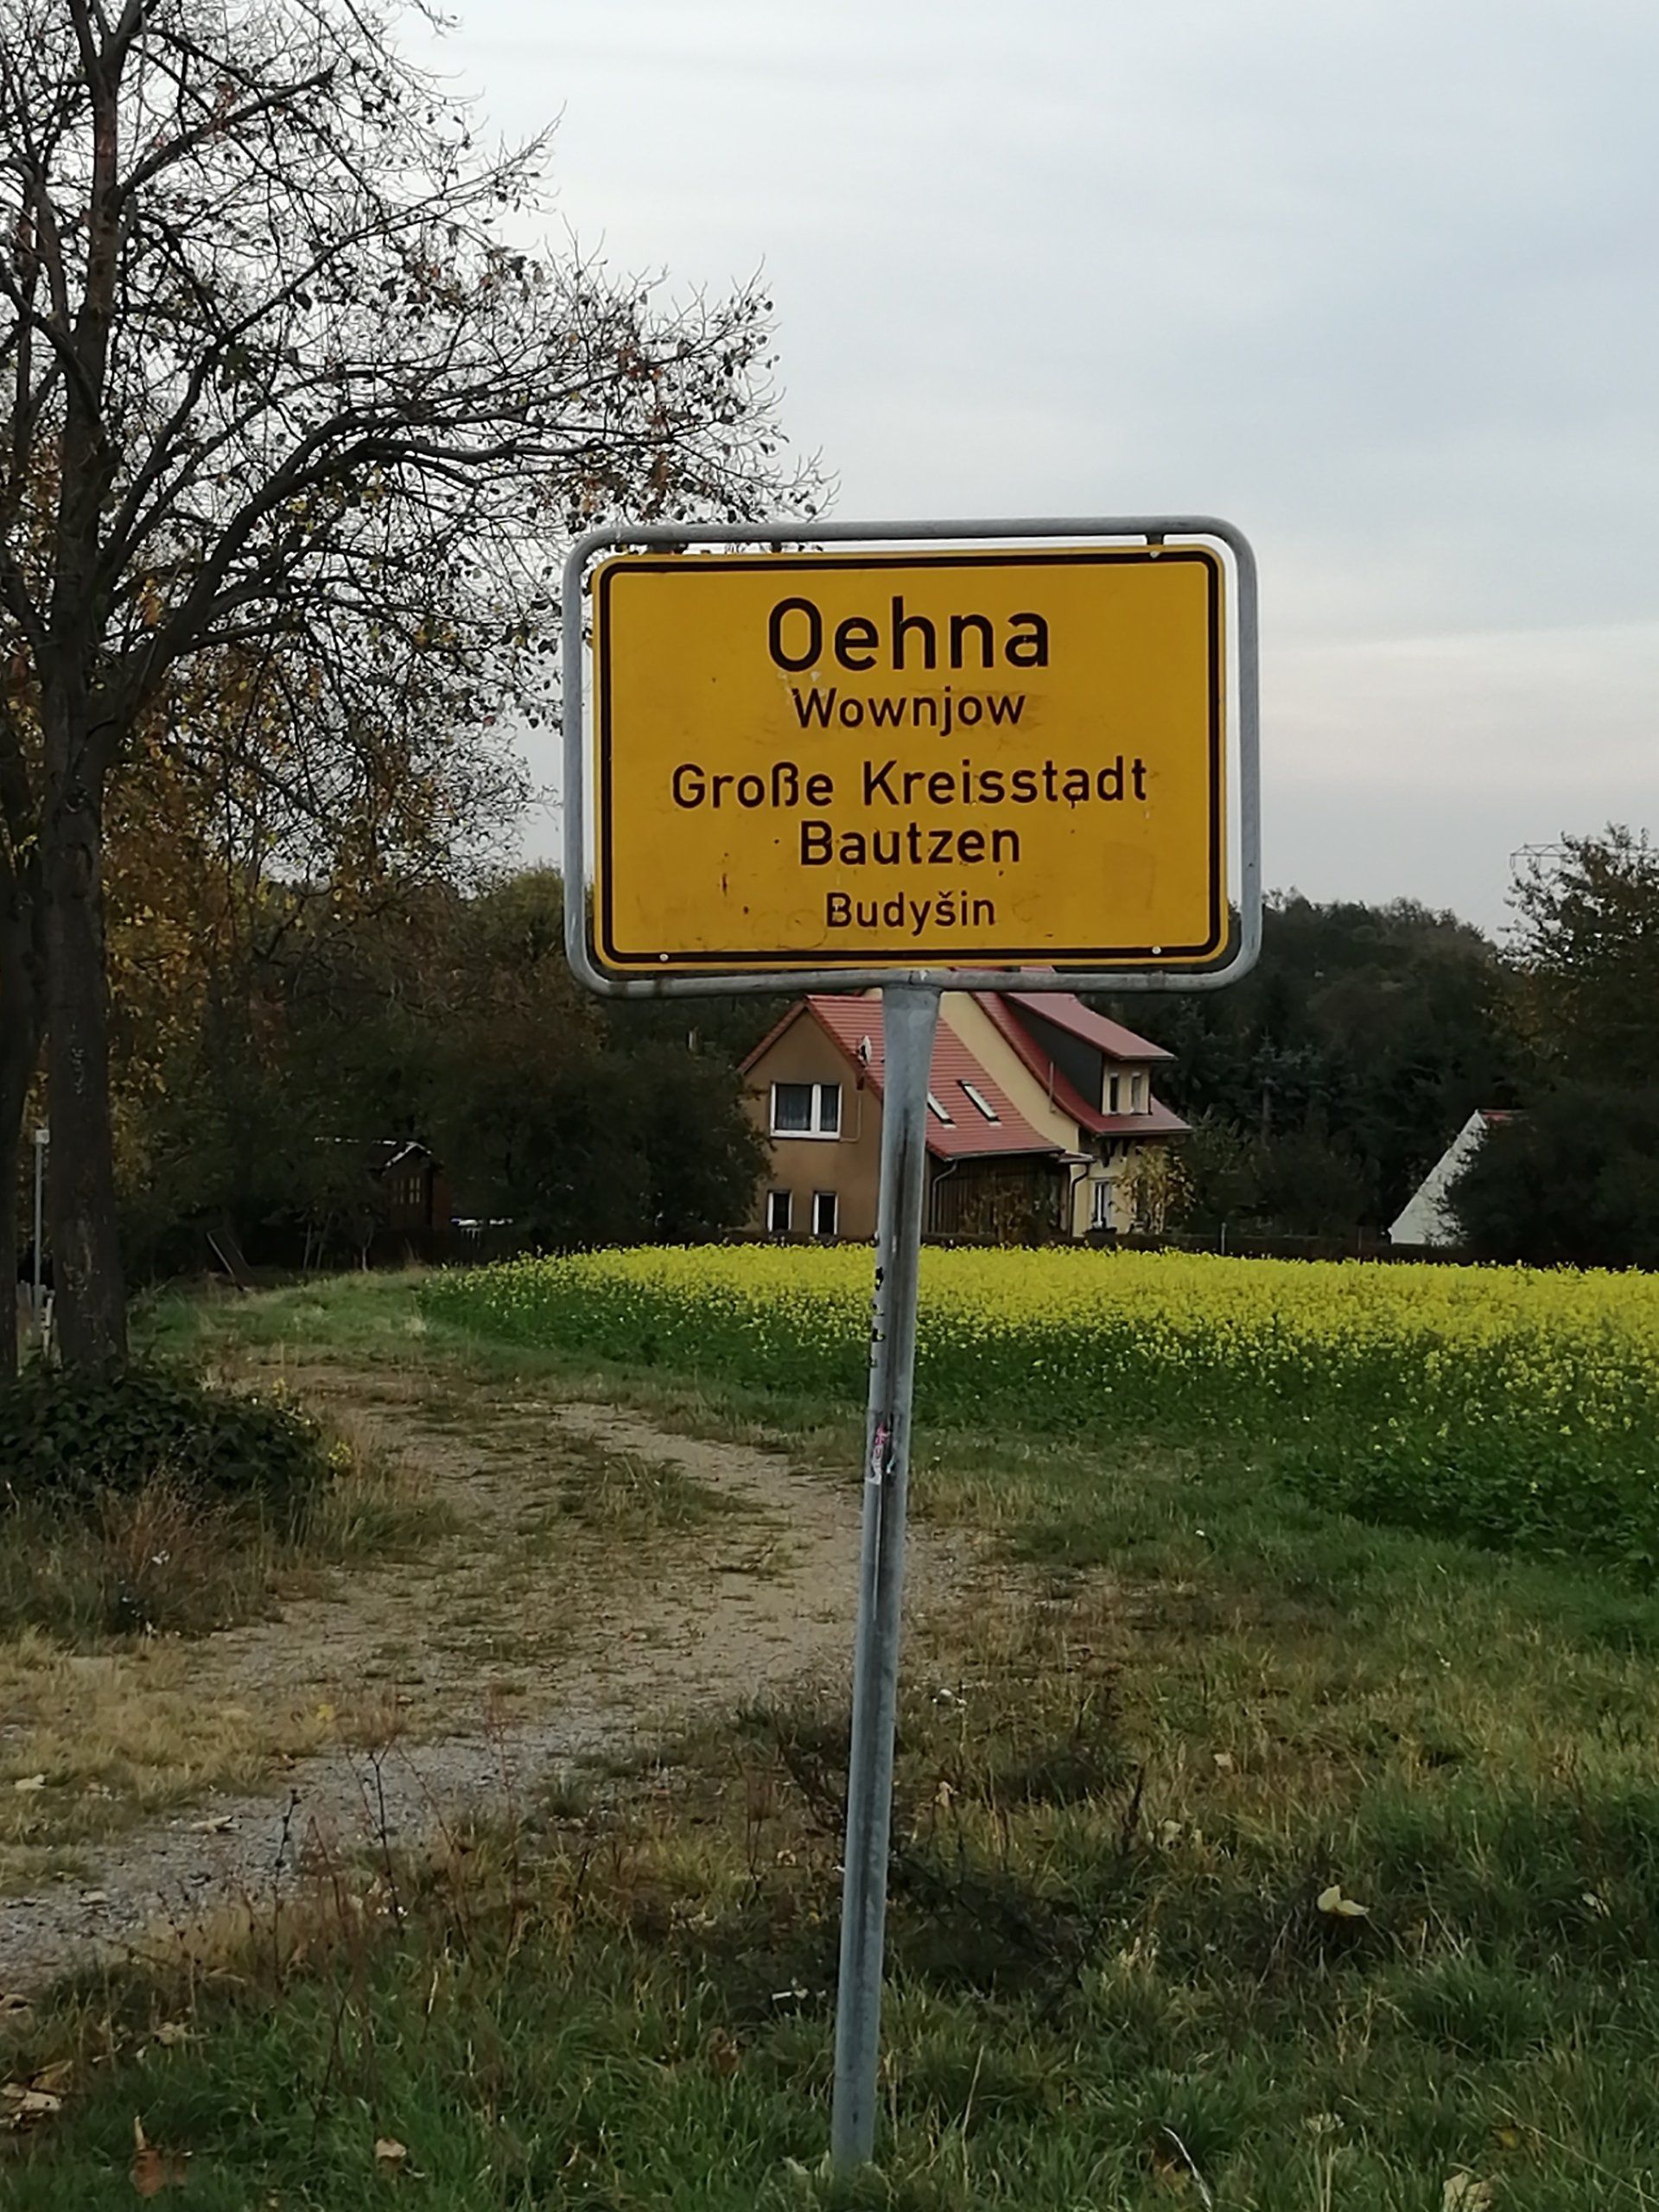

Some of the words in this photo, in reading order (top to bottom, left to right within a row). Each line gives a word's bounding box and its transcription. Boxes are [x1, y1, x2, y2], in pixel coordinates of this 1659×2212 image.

[768, 596, 1049, 671] Oehna
[791, 687, 1026, 736] Wownjow
[672, 761, 834, 809] Große
[863, 756, 1147, 806] Kreisstadt
[800, 820, 1020, 866] Bautzen
[826, 891, 995, 937] Budyšin
